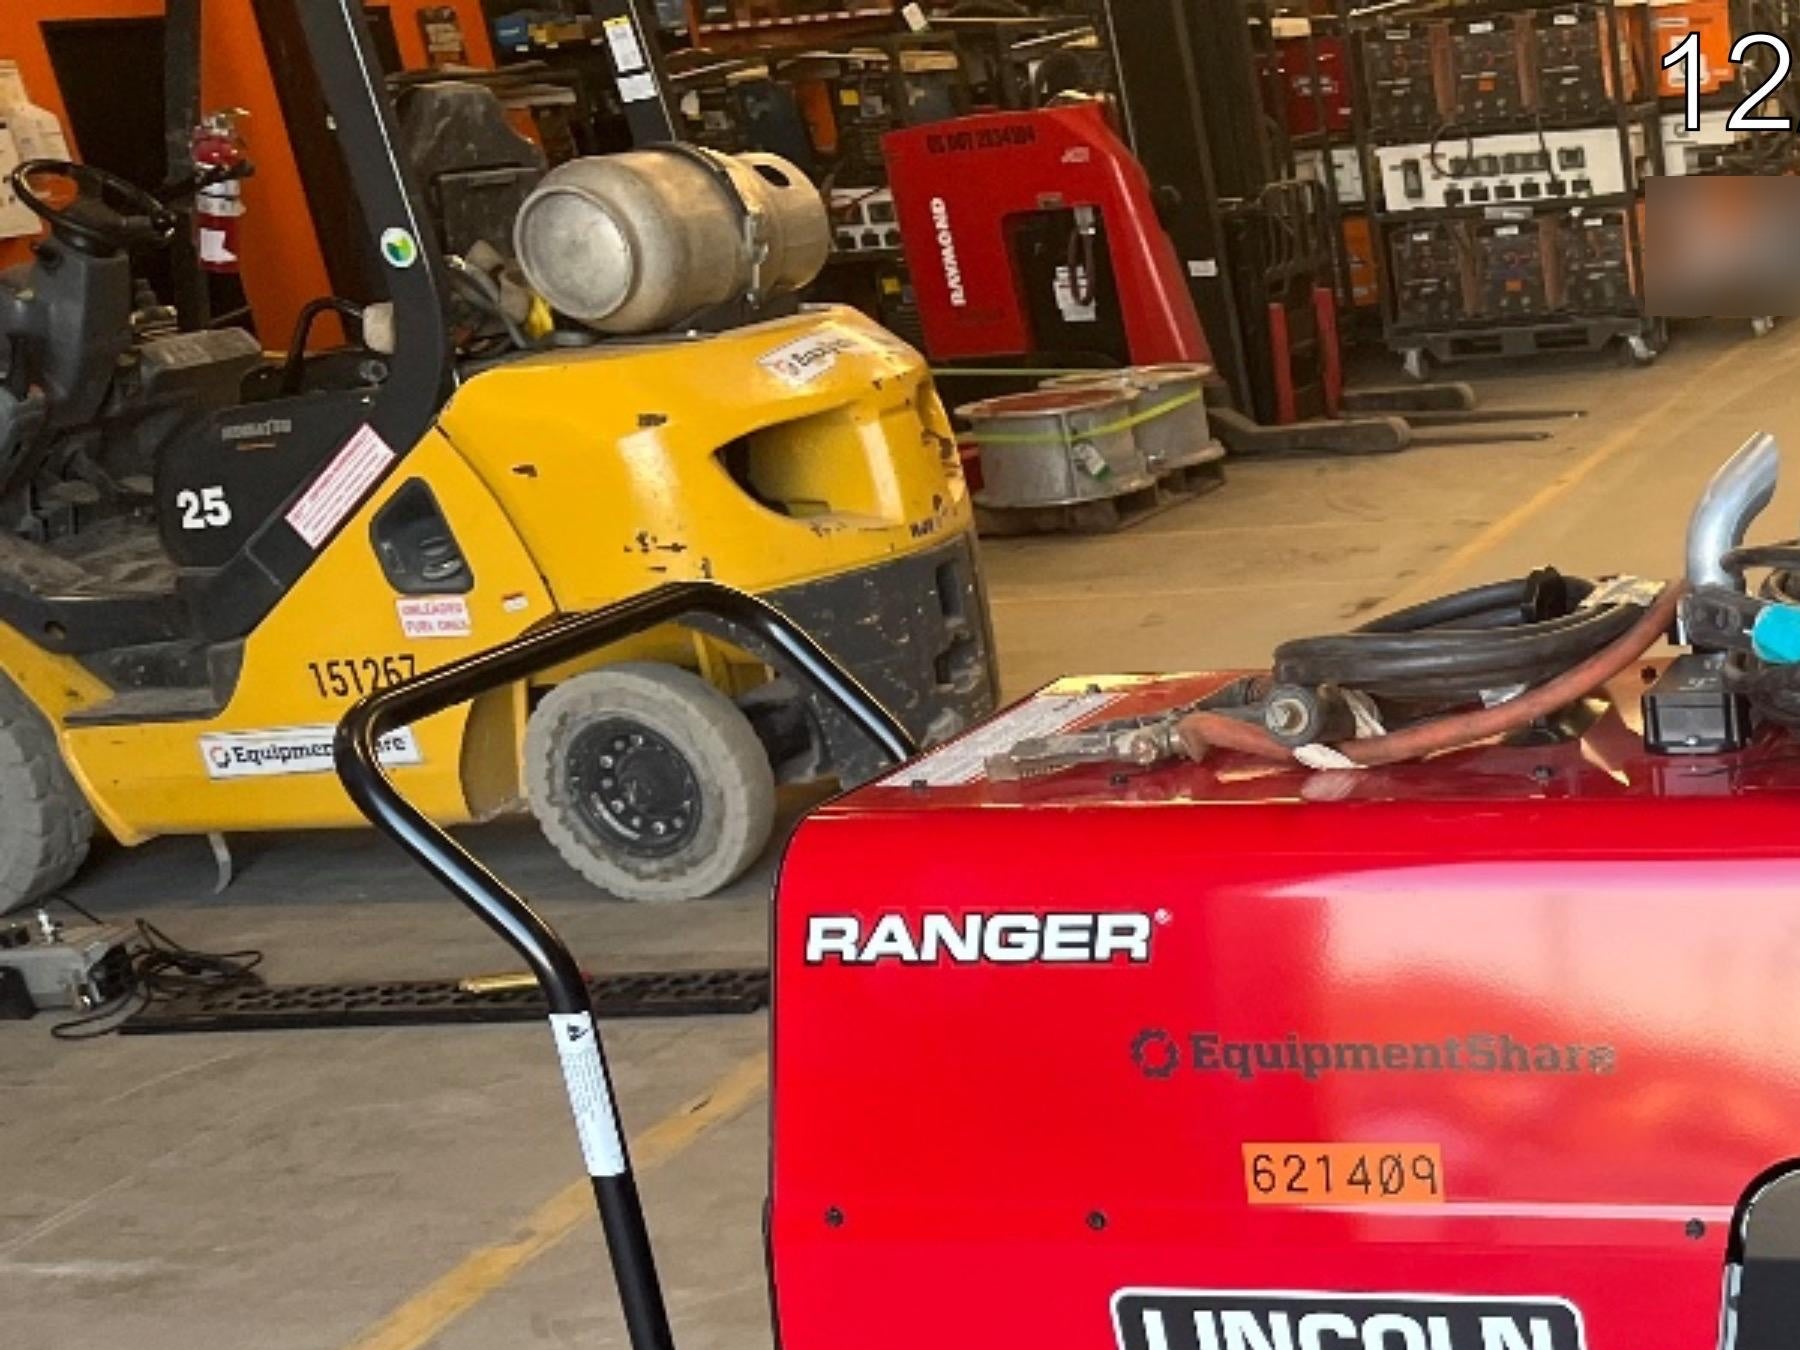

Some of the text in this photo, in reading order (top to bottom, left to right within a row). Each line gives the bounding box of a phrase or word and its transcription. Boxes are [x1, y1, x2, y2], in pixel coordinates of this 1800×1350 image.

[930, 197, 967, 306] RAYMOND
[176, 485, 232, 530] 25
[1188, 1034, 1616, 1078] EquipmentShare
[1252, 1152, 1440, 1195] 621409
